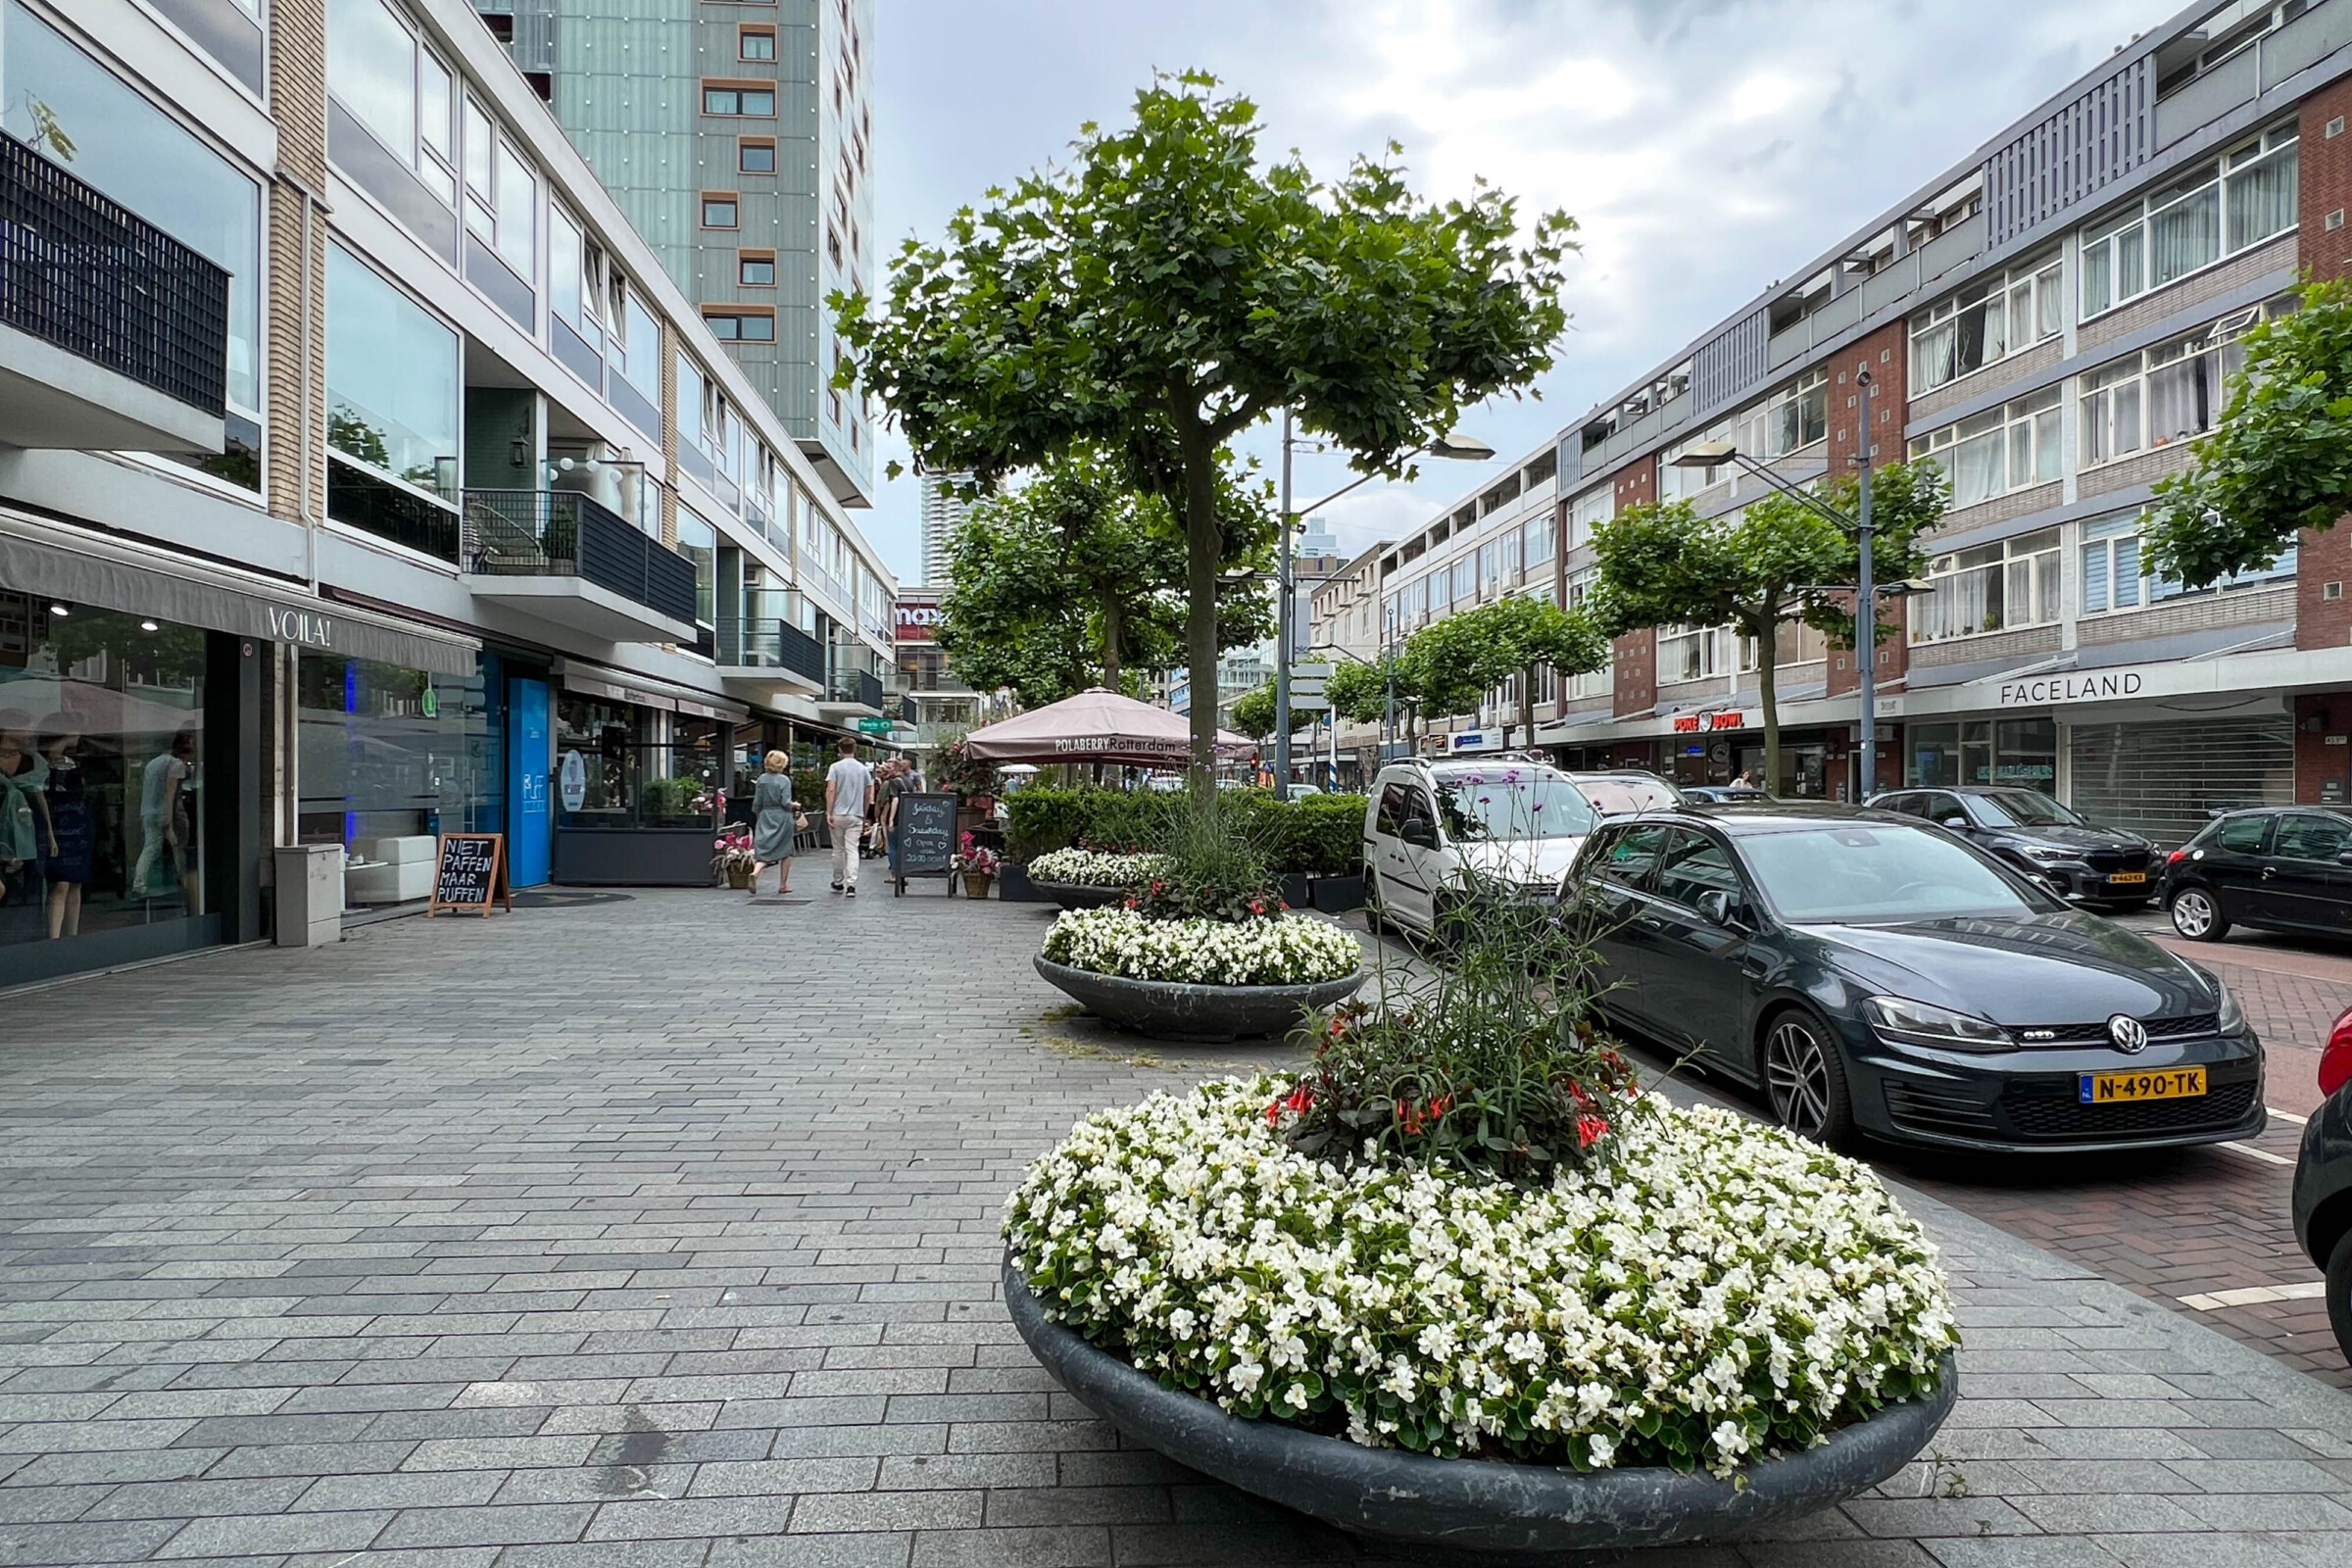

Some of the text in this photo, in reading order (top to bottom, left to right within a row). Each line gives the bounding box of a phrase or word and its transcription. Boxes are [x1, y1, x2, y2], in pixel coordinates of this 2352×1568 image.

[269, 607, 331, 647] VOILA!
[2001, 672, 2142, 704] FACELAND
[1713, 712, 1743, 729] BOWL
[1055, 737, 1176, 753] POLABERRY Rotterdam
[446, 839, 489, 856] NIET
[442, 855, 493, 872] PAFFEN
[439, 872, 477, 886] MAAR
[436, 887, 485, 903] PUFFEN
[2099, 1072, 2200, 1099] N-490-TK
